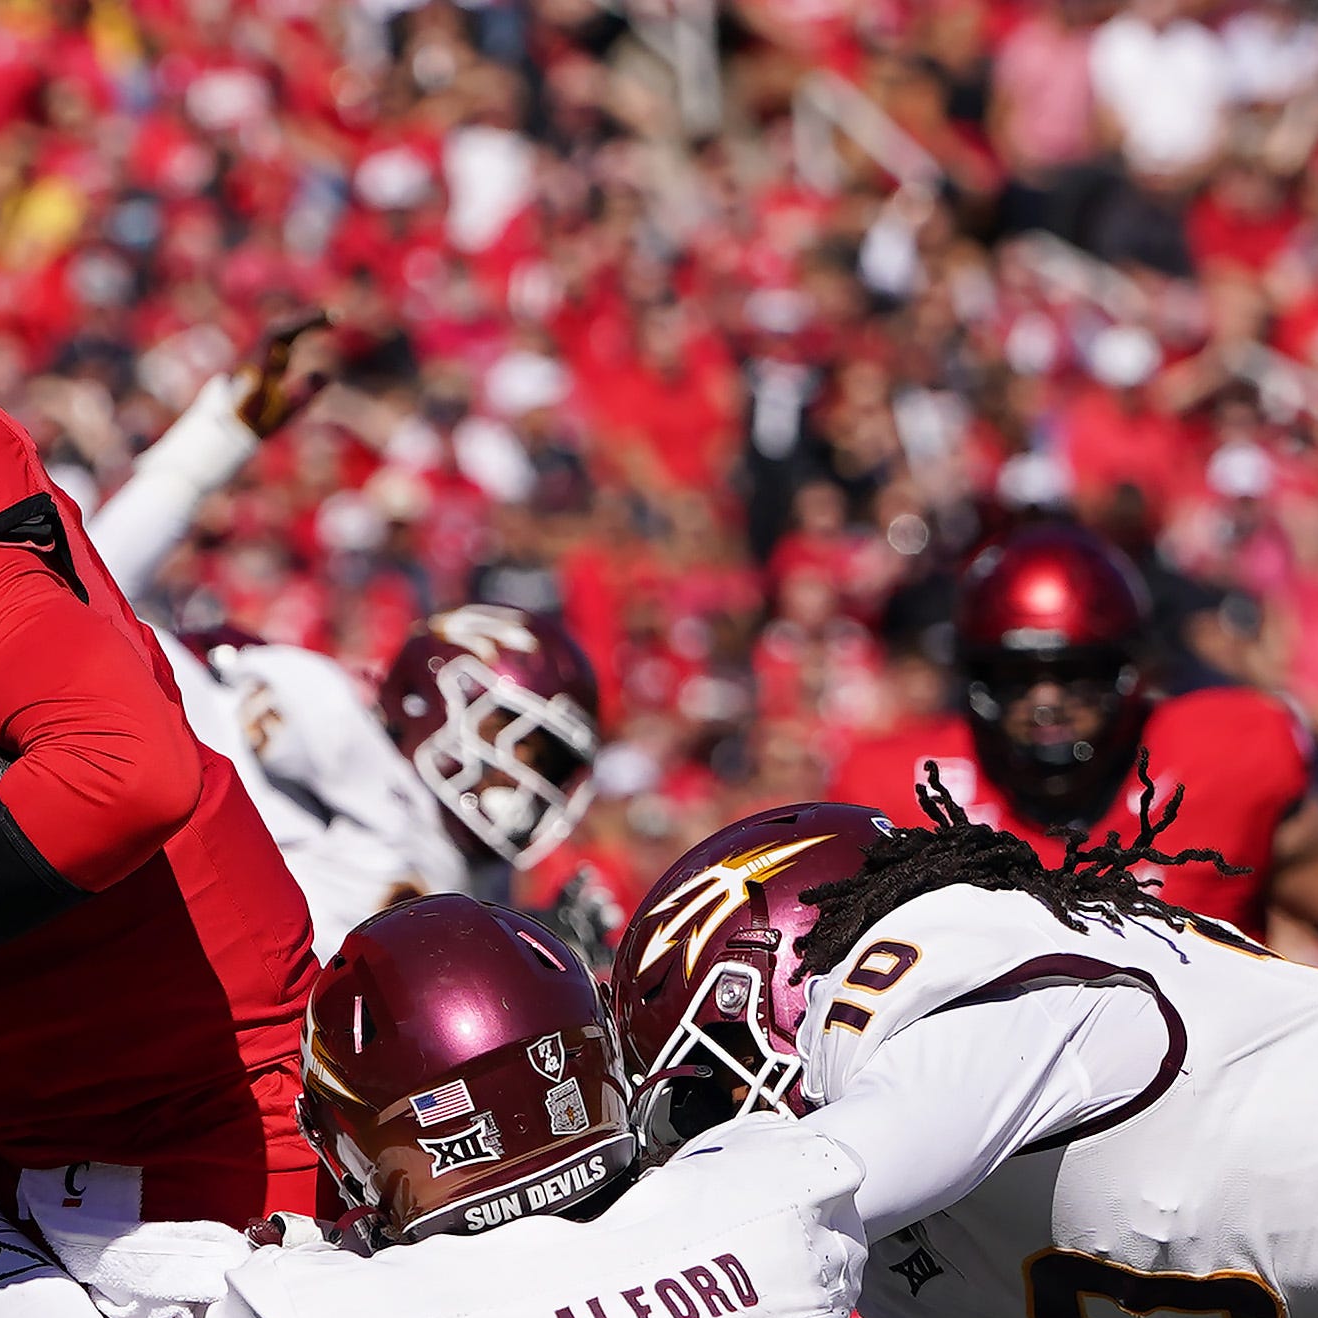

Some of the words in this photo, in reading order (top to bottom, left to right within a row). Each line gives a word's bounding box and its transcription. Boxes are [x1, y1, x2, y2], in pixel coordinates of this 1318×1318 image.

[824, 938, 922, 1035] 10
[465, 1193, 523, 1231] SUN
[526, 1155, 607, 1212] DEVILS
